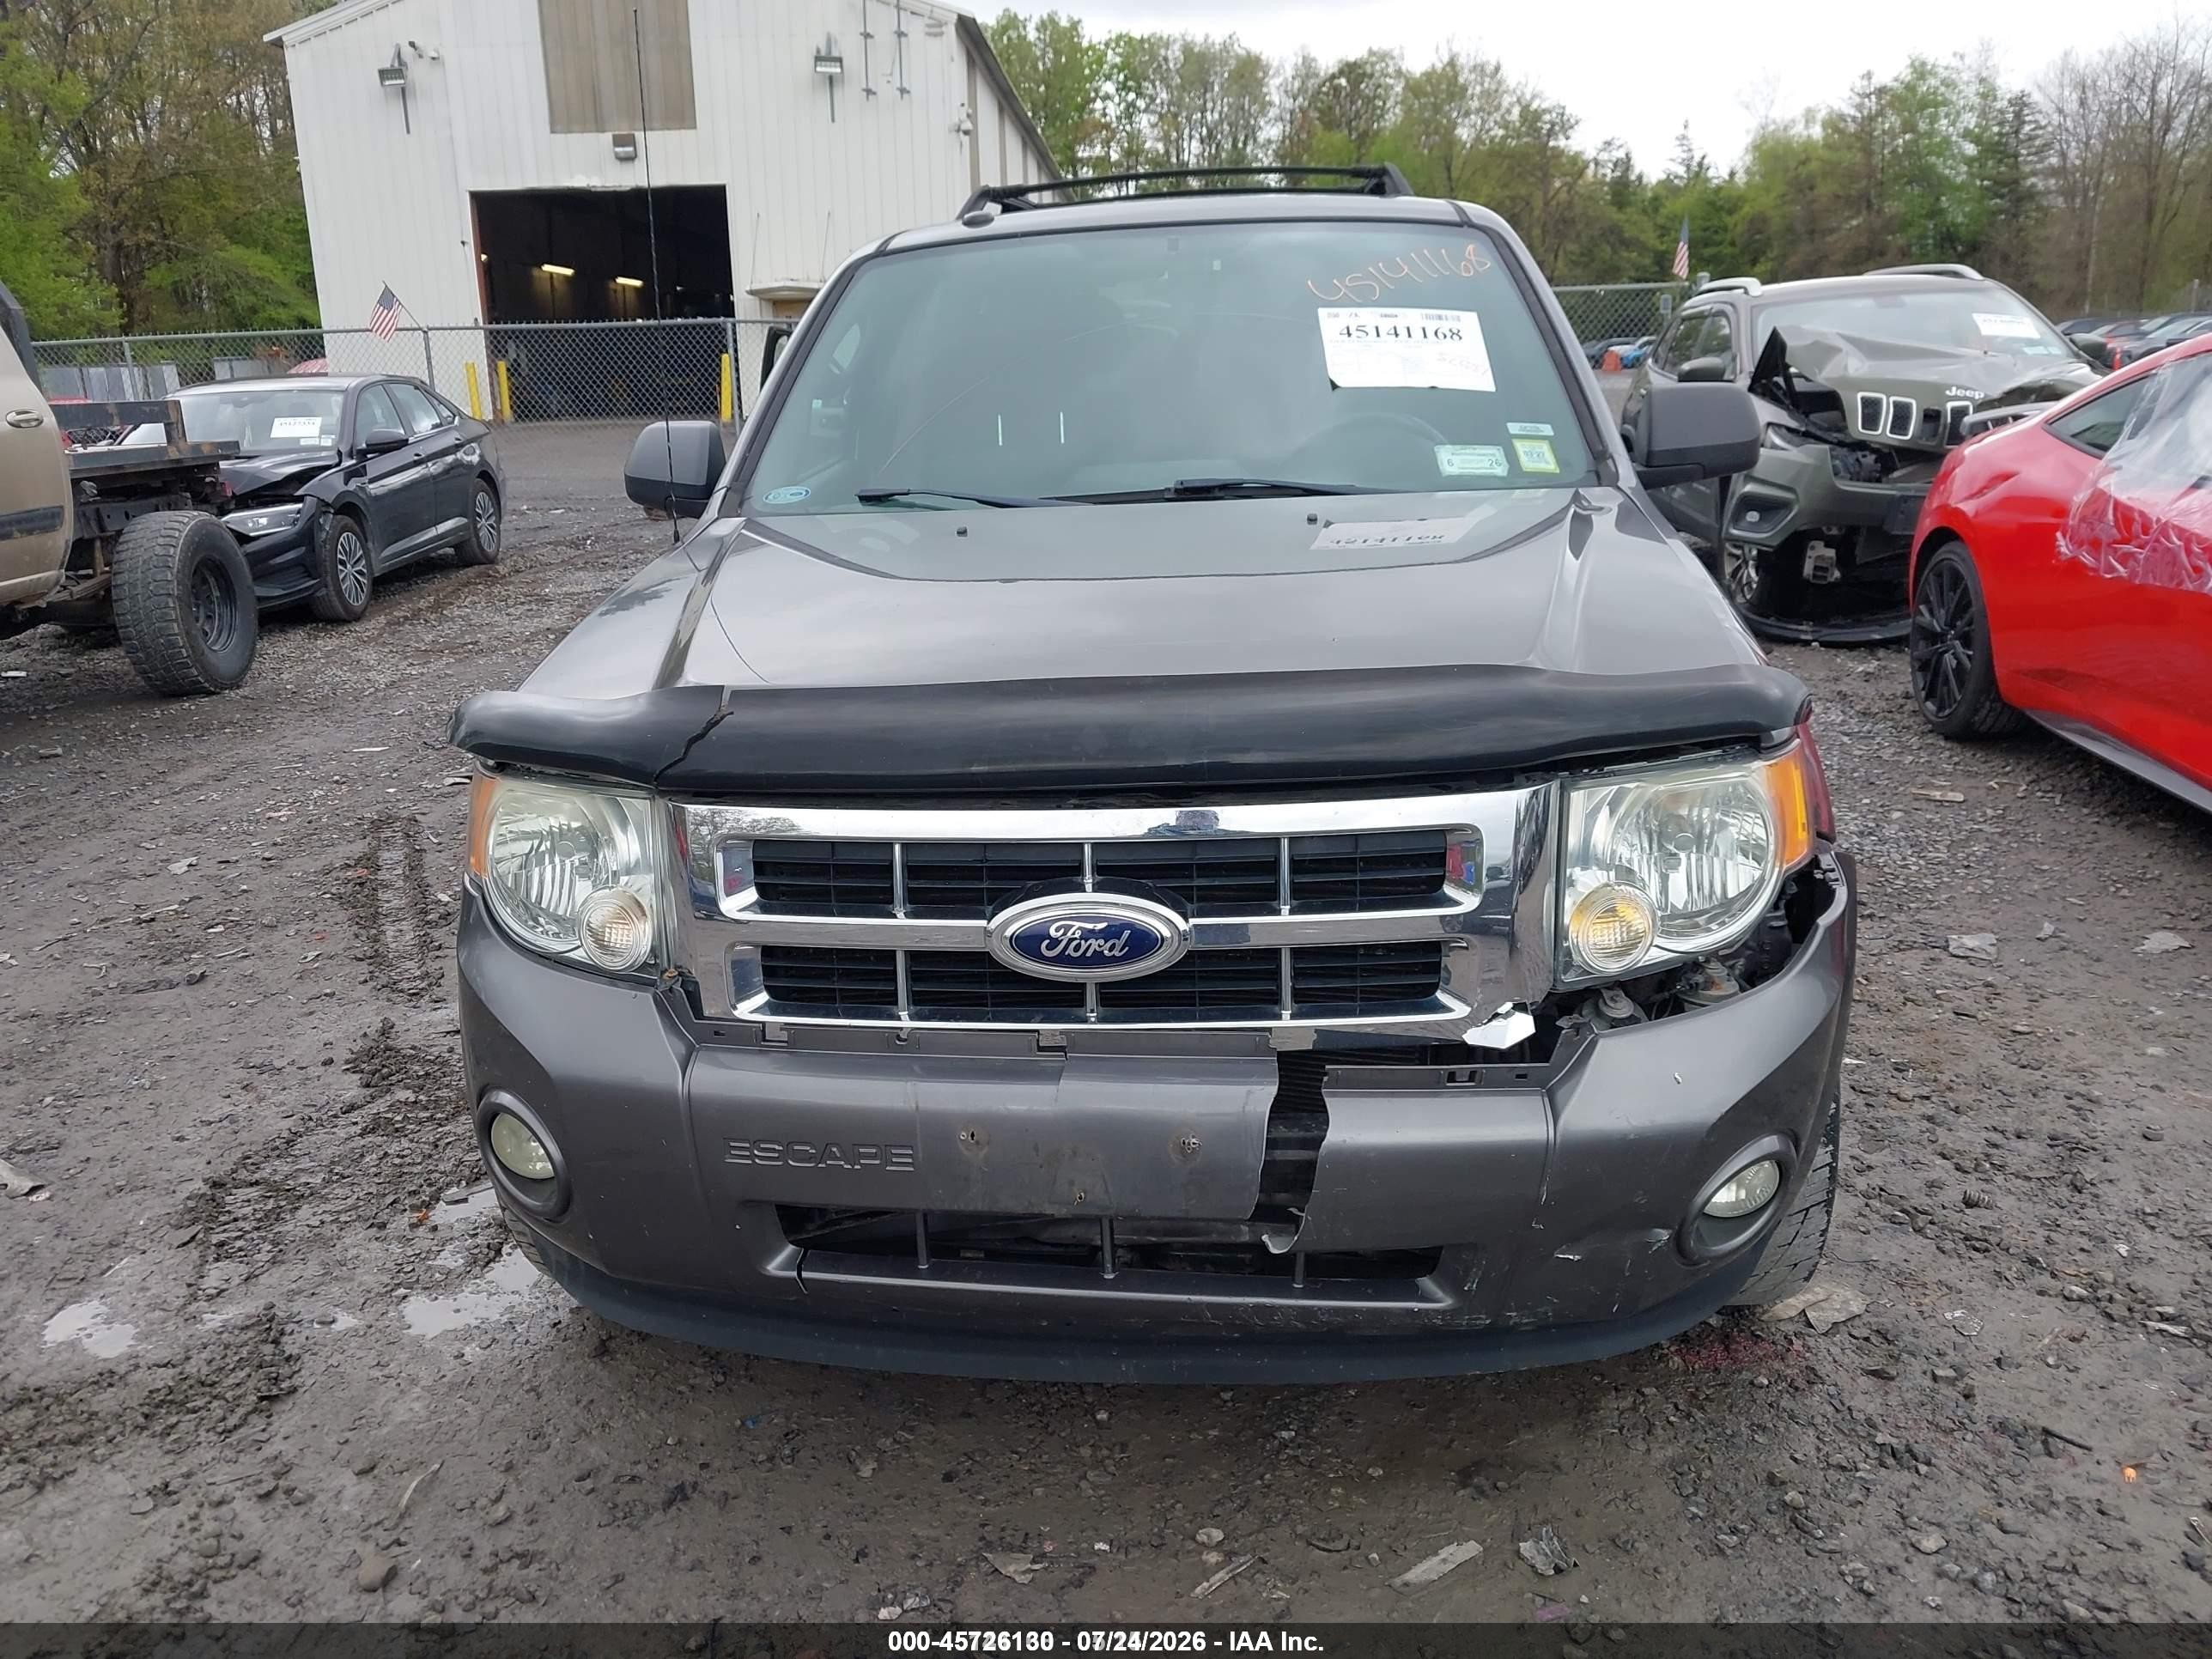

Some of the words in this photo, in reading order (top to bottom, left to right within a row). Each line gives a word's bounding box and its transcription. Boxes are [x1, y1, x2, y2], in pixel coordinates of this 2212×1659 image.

[1339, 324, 1463, 342] 45141168
[1945, 386, 1985, 399] Jeep
[1447, 459, 1455, 467] 6
[1040, 921, 1131, 957] Ford
[722, 1137, 915, 1171] ESCAPE
